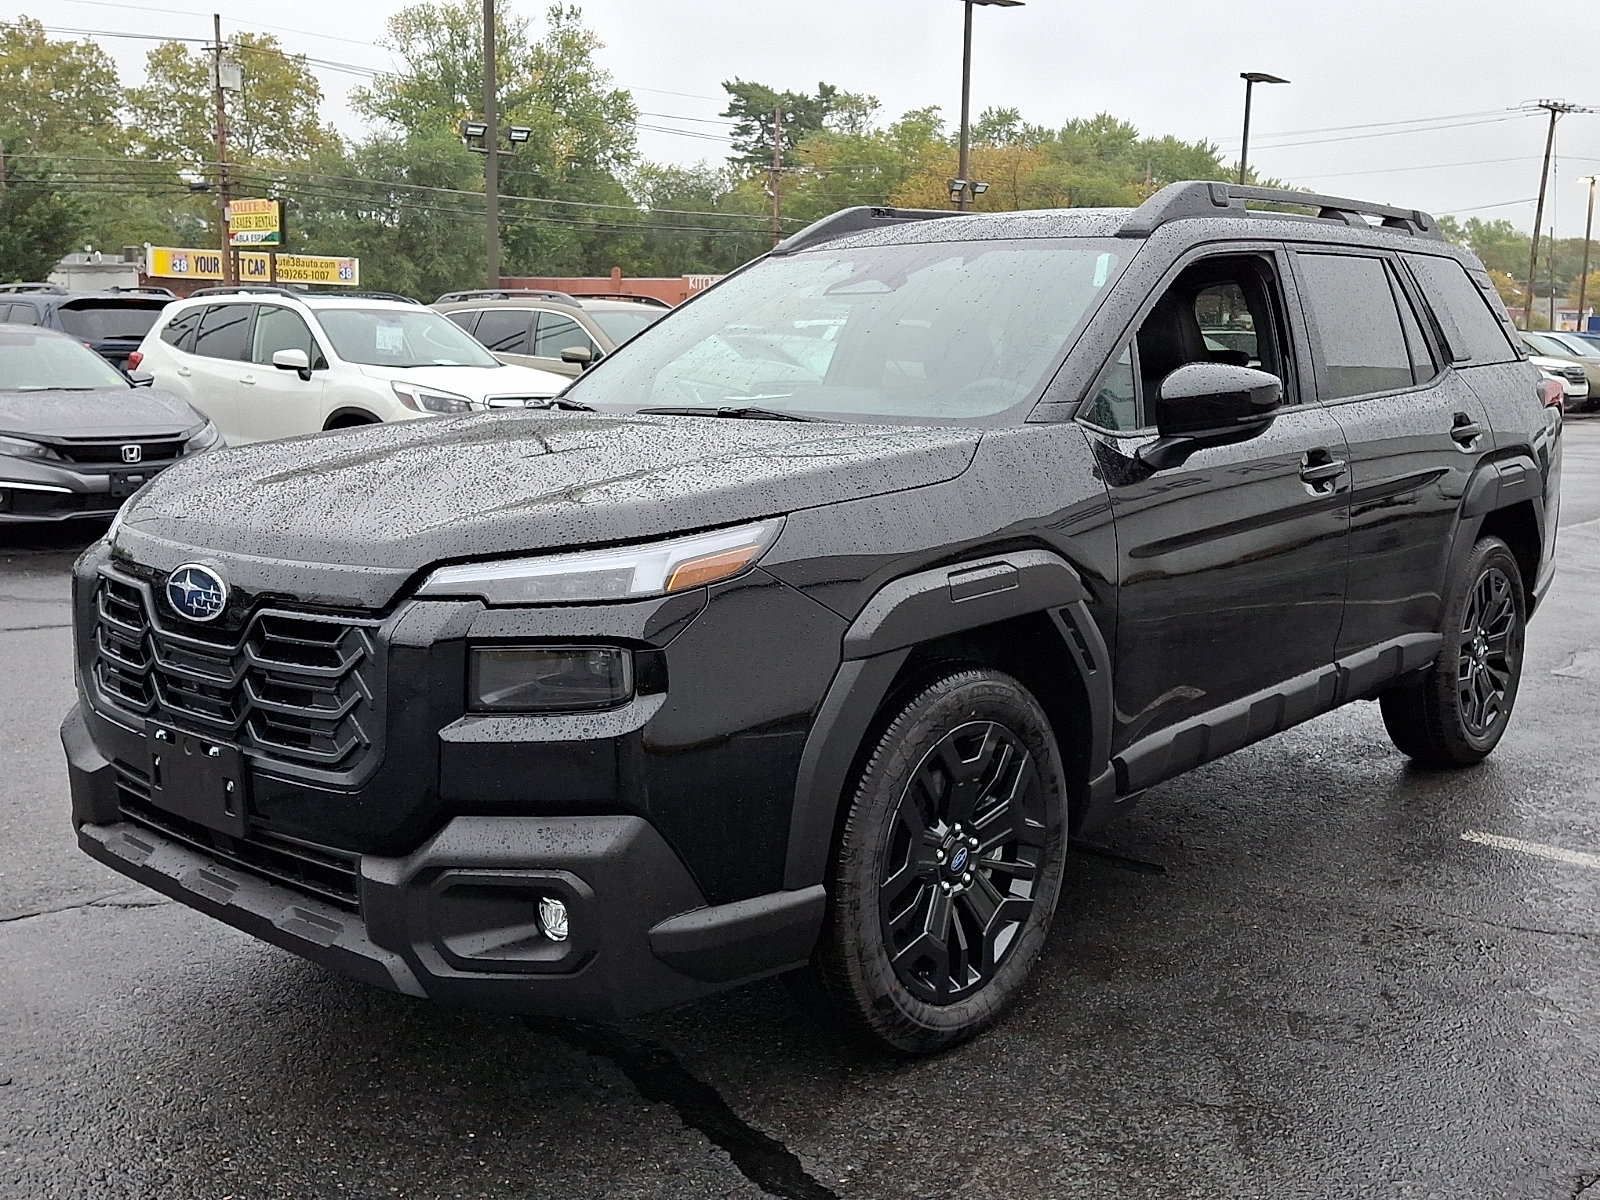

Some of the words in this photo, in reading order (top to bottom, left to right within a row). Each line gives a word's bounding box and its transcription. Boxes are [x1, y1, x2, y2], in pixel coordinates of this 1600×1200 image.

[230, 201, 260, 213] OUTE
[254, 215, 277, 228] RENTALS
[172, 259, 188, 271] 38
[193, 255, 220, 274] YOUR
[248, 259, 266, 276] CAR
[278, 257, 336, 269] ute38auto.com
[339, 267, 352, 279] 38
